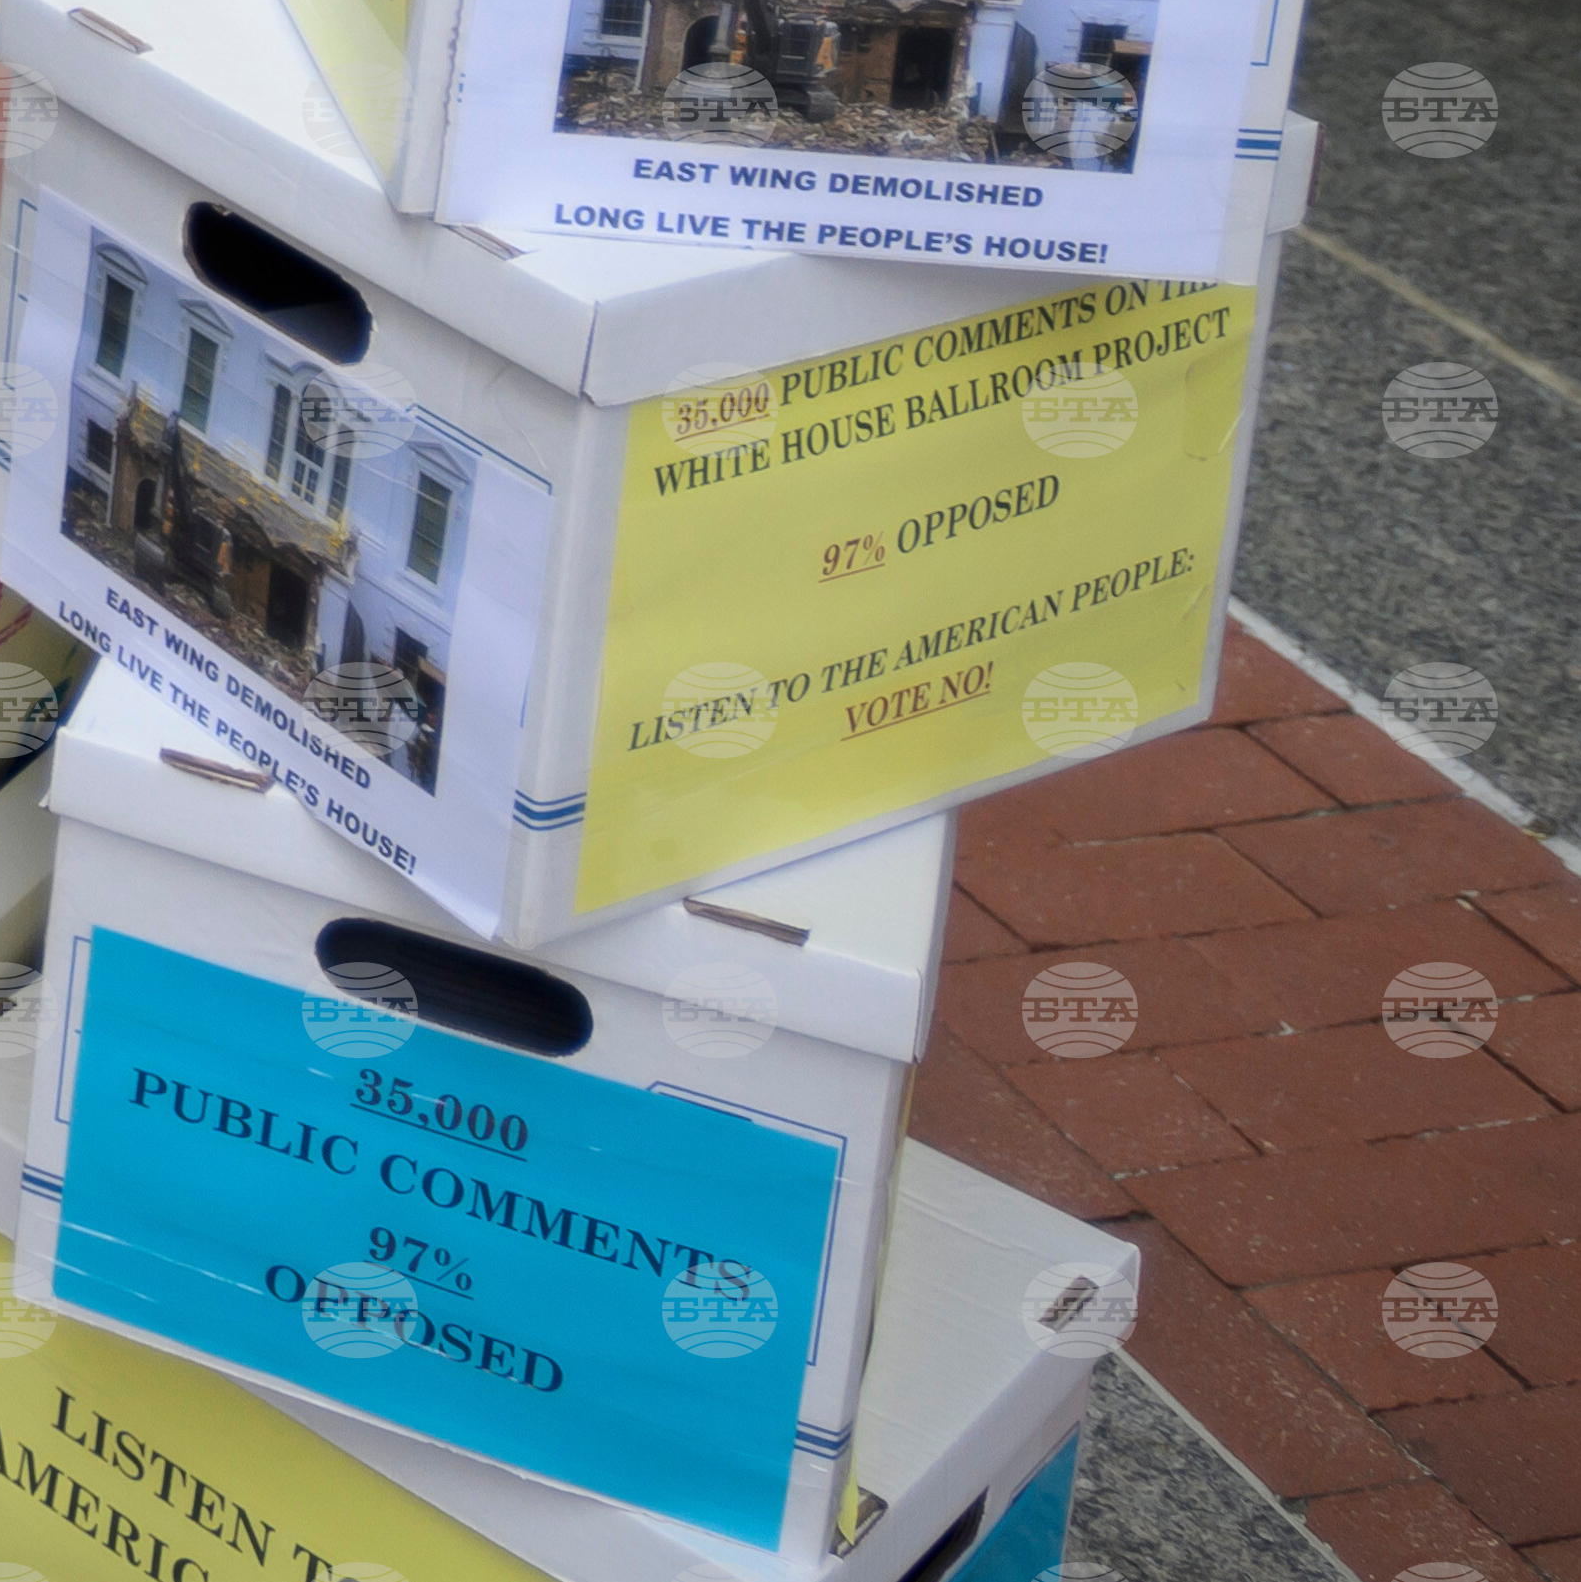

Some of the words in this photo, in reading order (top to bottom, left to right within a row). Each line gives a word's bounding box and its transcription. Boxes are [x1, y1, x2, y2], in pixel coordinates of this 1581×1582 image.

[554, 203, 646, 232] LONG
[656, 210, 730, 238] LIVE
[741, 217, 806, 244] THE
[983, 234, 1108, 266] HOUSE!
[632, 158, 719, 188] EAST
[728, 165, 818, 194] WING
[827, 172, 1044, 209] DEMOLISHED
[652, 439, 771, 498] WHITE
[780, 403, 897, 467] HOUSE
[904, 350, 1084, 429] BALLROOM
[1093, 307, 1231, 376] PROJECT
[779, 343, 905, 407] PUBLIC
[913, 293, 1097, 370] COMMENTS
[1105, 279, 1149, 317] ON
[821, 531, 886, 577] 97%
[896, 473, 1061, 556] OPPOSED
[105, 585, 160, 634] EAST
[162, 624, 221, 685] WING
[224, 671, 372, 792] DEMOLISHED
[627, 689, 756, 752] LISTEN
[766, 672, 812, 709] TO
[821, 647, 889, 696] THE
[893, 589, 1066, 673] AMERICAN
[1069, 546, 1196, 614] PEOPLE:
[842, 680, 932, 735] VOTE
[937, 660, 995, 709] NO!
[58, 599, 114, 658] LONG
[115, 642, 164, 695] LIVE
[169, 681, 212, 730] THE
[325, 794, 419, 877] HOUSE!
[356, 1068, 528, 1152] 35,000
[128, 1066, 360, 1176] PUBLIC
[378, 1151, 754, 1304] COMMENTS
[366, 1225, 475, 1292] 97%
[264, 1263, 564, 1395] OPPOSED
[51, 1386, 277, 1568] LISTEN
[292, 1542, 356, 1582] T
